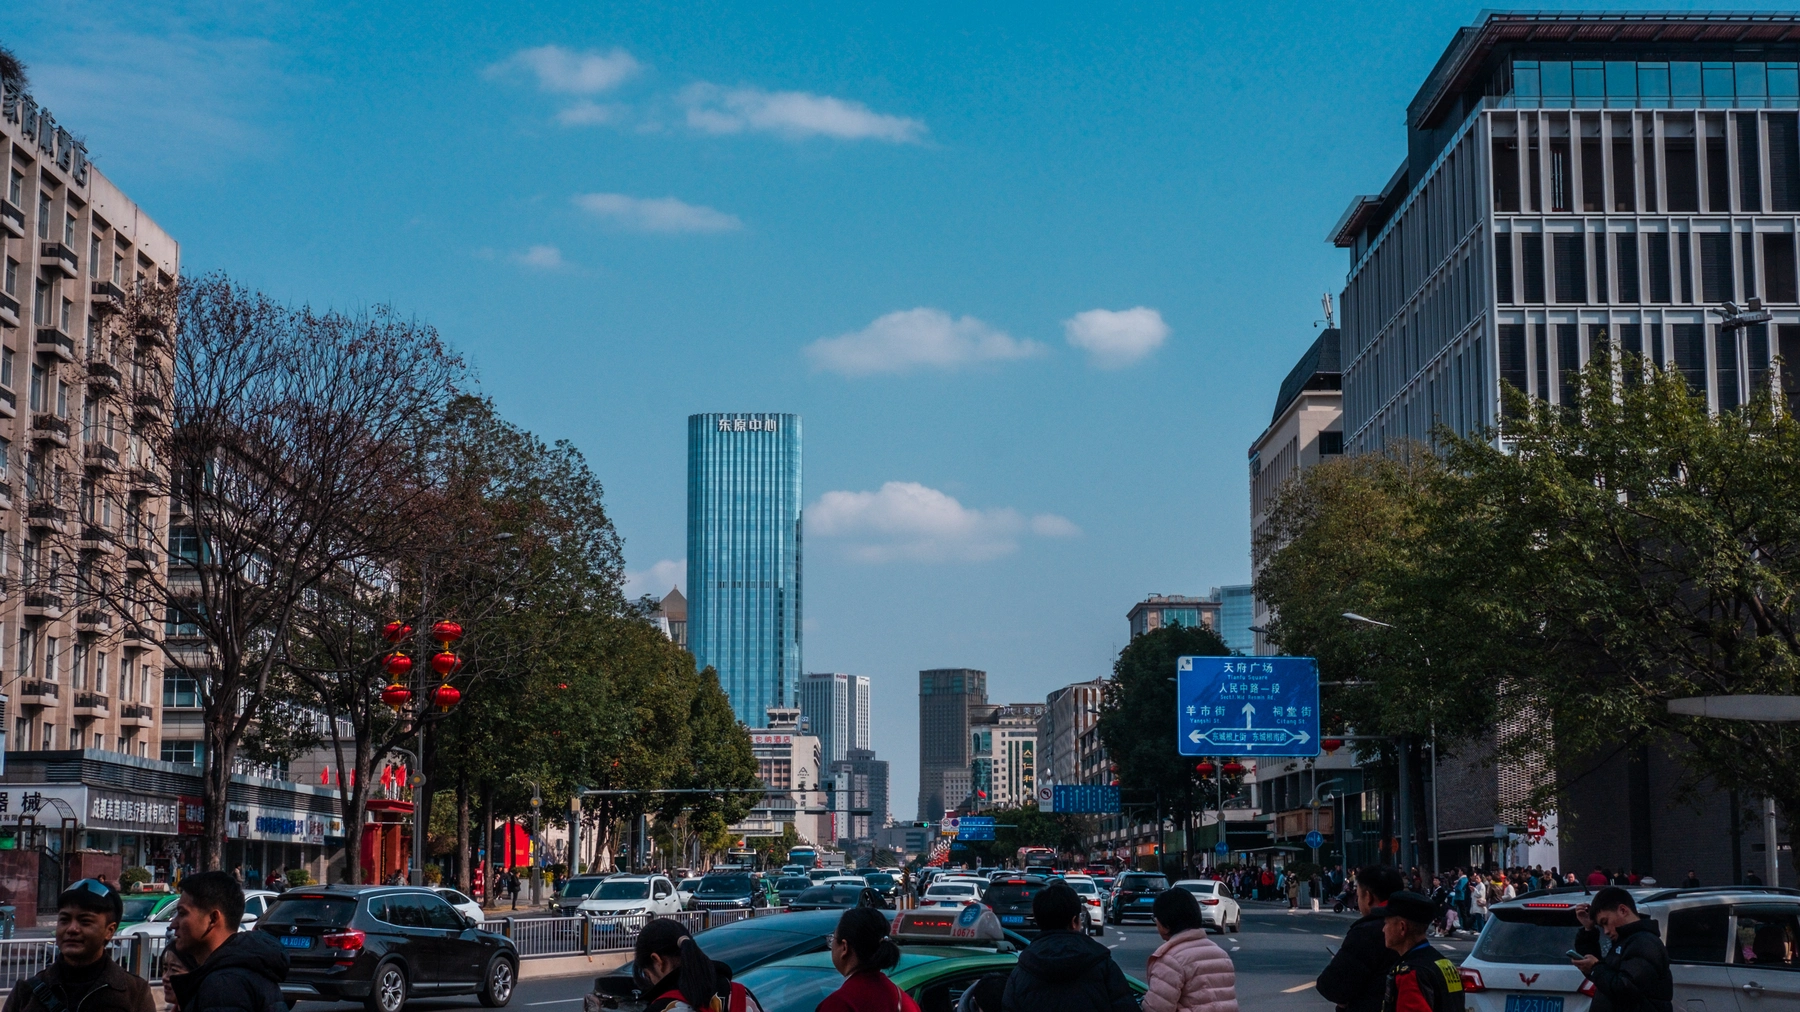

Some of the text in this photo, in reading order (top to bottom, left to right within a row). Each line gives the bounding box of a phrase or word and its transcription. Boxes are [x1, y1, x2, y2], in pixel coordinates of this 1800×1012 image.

[719, 419, 777, 431] 东原中心
[1223, 662, 1273, 673] 天府广场
[1219, 683, 1280, 693] 人民中路一段
[1186, 705, 1225, 716] 羊市街
[1272, 705, 1312, 717] 祠堂街
[1212, 732, 1247, 741] 东城根上街
[952, 929, 975, 938] 10675
